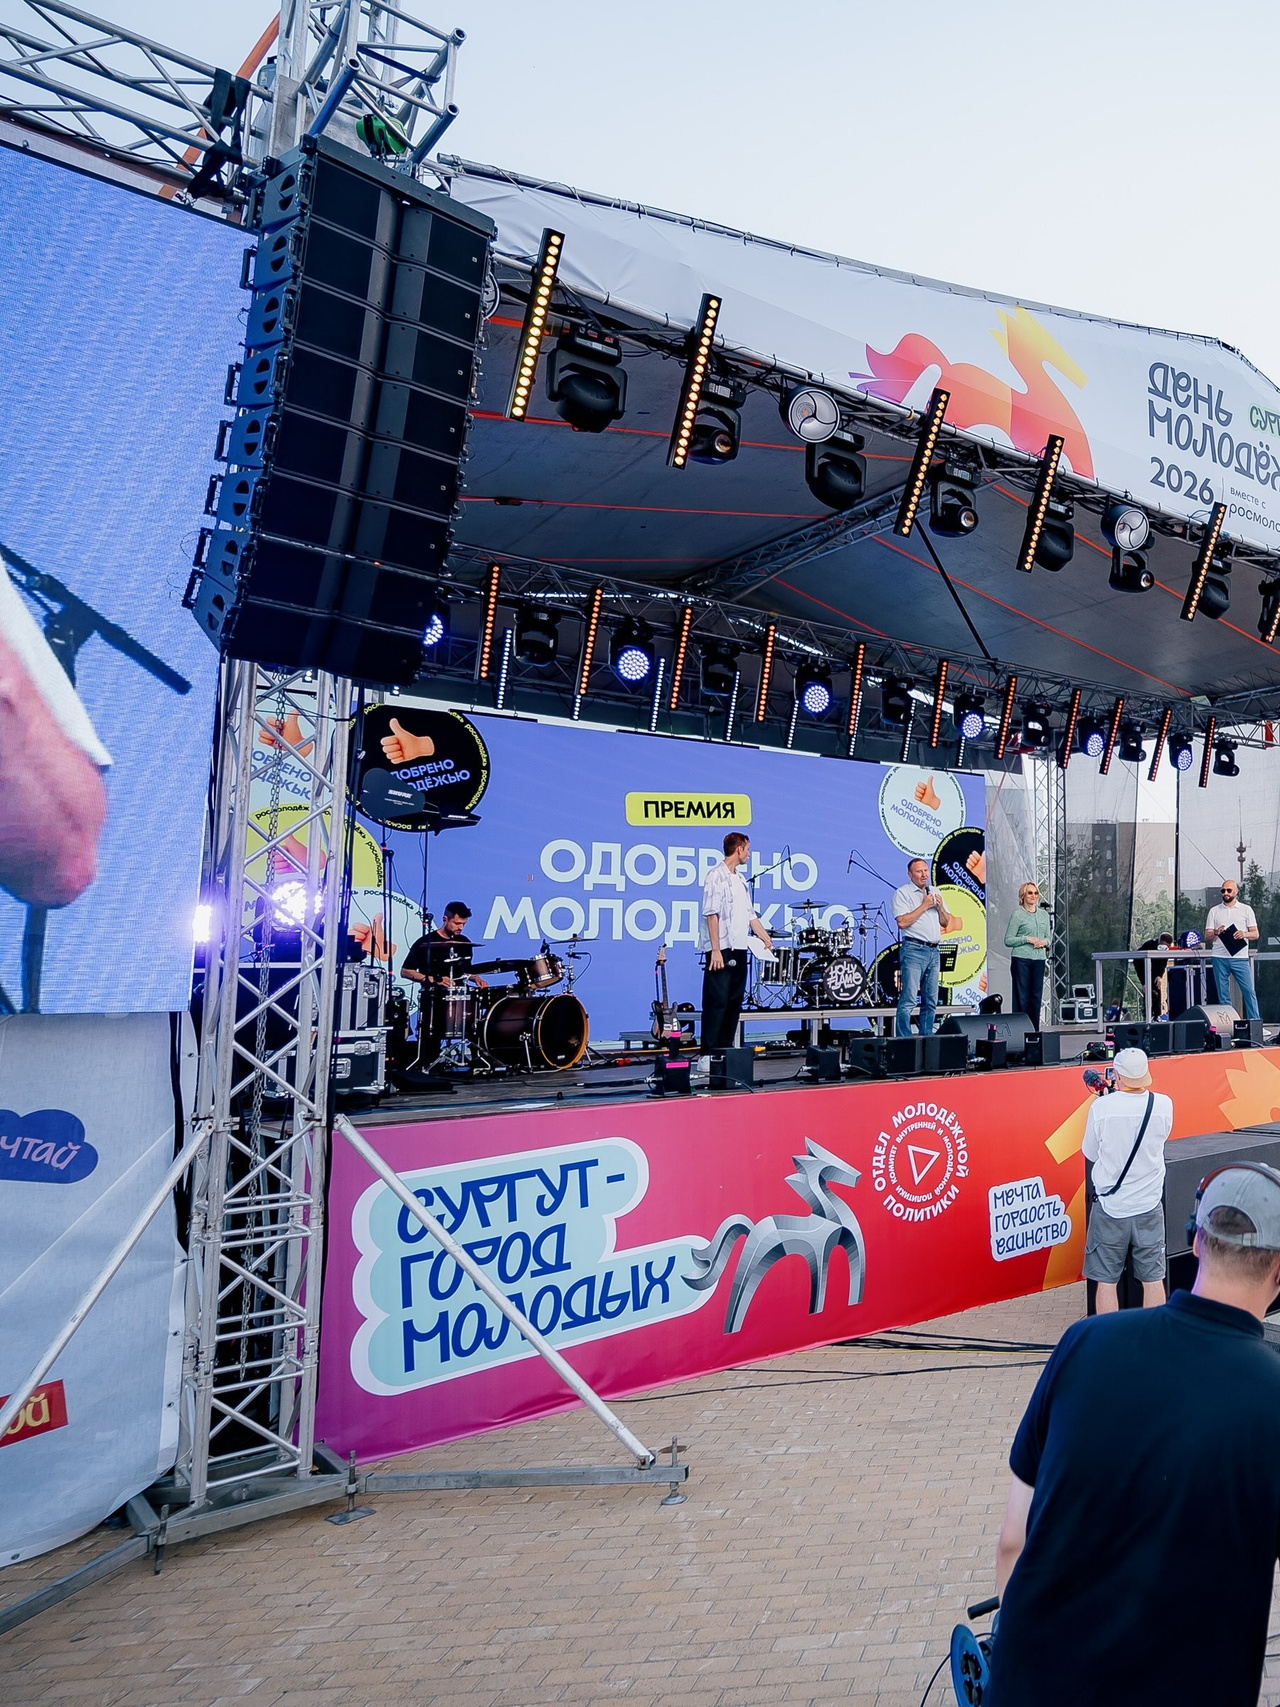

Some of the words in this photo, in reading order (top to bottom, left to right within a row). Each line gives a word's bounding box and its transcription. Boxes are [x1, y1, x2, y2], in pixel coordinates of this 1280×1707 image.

[1150, 456, 1215, 506] 2026
[1230, 486, 1260, 506] вместе
[390, 759, 455, 781] ДОБРЕНО
[643, 800, 736, 819] ПРЕМИЯ
[890, 804, 945, 840] МОЛОДЁЖЬЮ
[901, 798, 942, 827] ОДОБРЕНО
[539, 839, 818, 893] ОДОБРНО
[952, 861, 986, 901] ОДОБРЕНО
[483, 895, 856, 948] МОЛОДЖЬЮ
[872, 1131, 891, 1192] ОТДЕЛ
[888, 1144, 898, 1185] КОМИТЕТ
[895, 1121, 936, 1144] ВНУТРЕННЕЙ
[892, 1102, 970, 1178] МОЛОДЁЖНОЙ
[882, 1184, 960, 1222] ПОЛИТИКИ
[400, 1222, 572, 1310] ГОРОД
